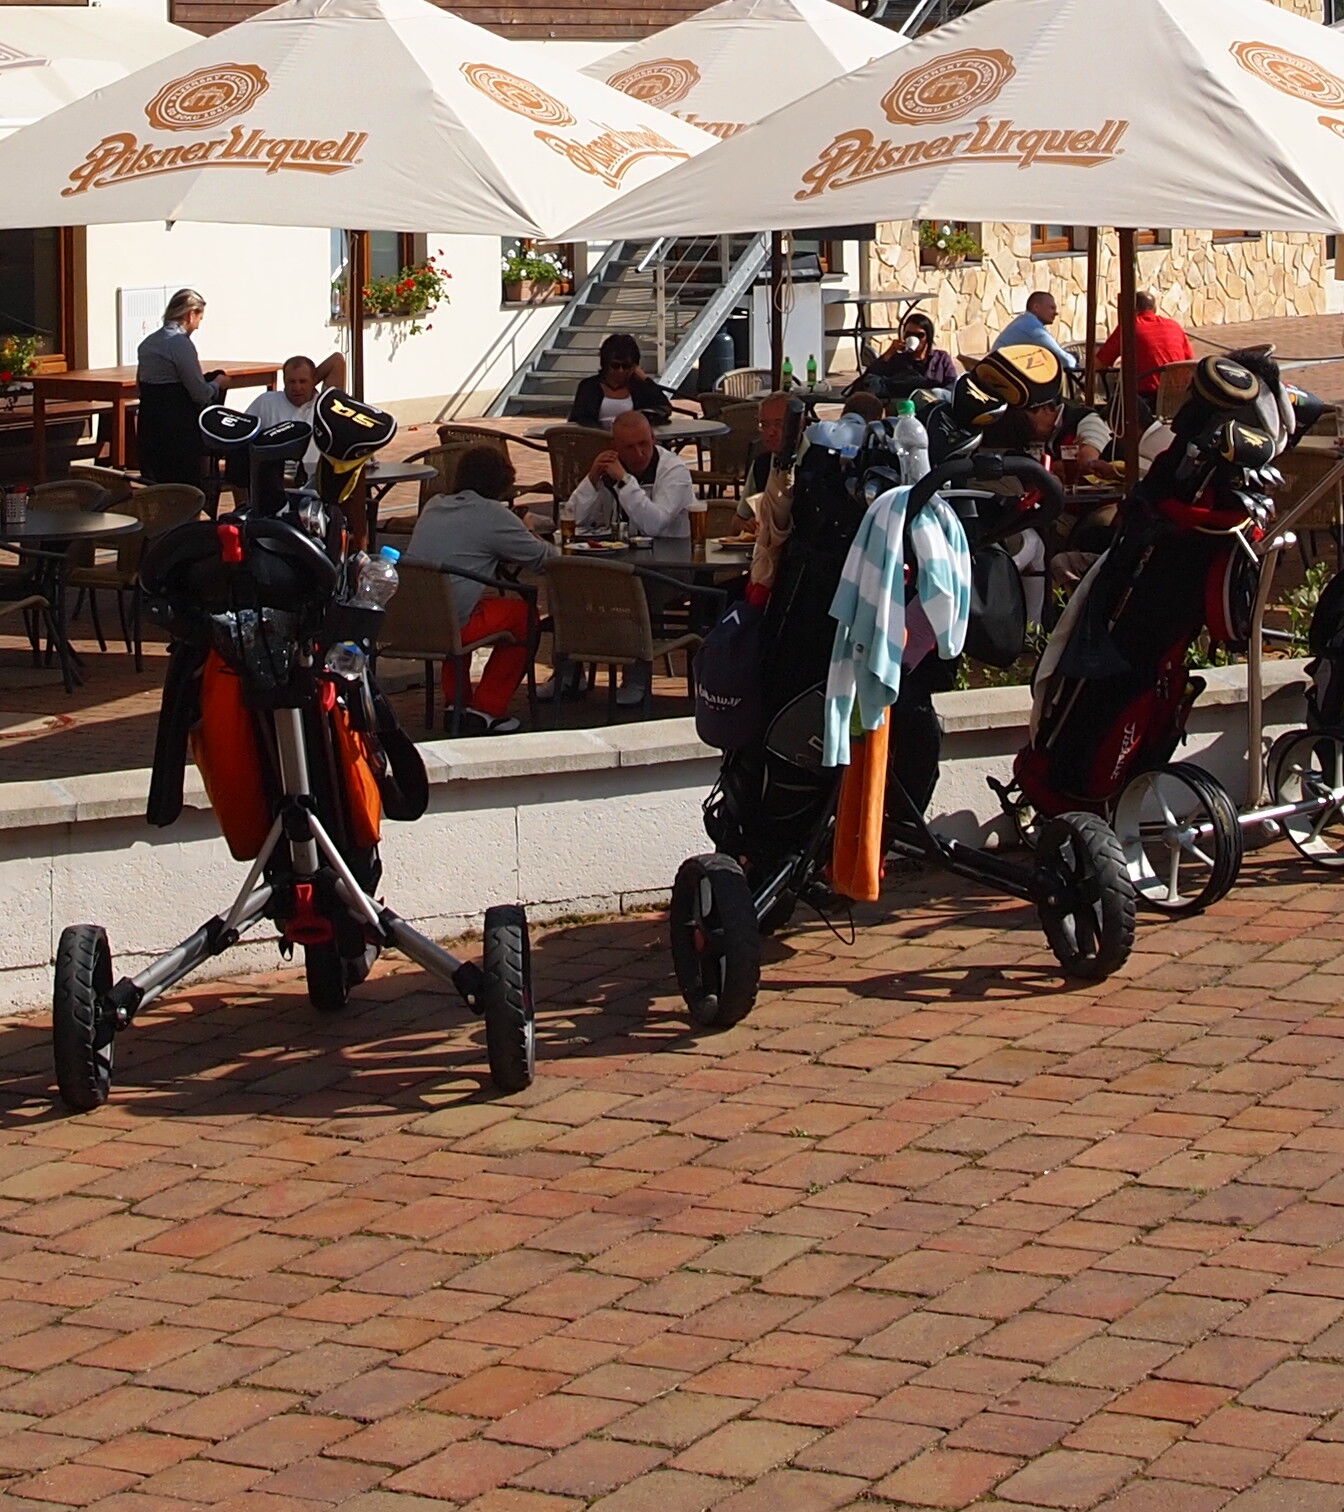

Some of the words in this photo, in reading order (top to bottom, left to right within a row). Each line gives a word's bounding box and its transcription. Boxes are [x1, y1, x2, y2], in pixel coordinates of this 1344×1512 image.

[60, 131, 227, 198] Pilsner
[219, 124, 369, 176] Urquell
[793, 127, 976, 201] Pilsner
[964, 115, 1130, 170] Urquell
